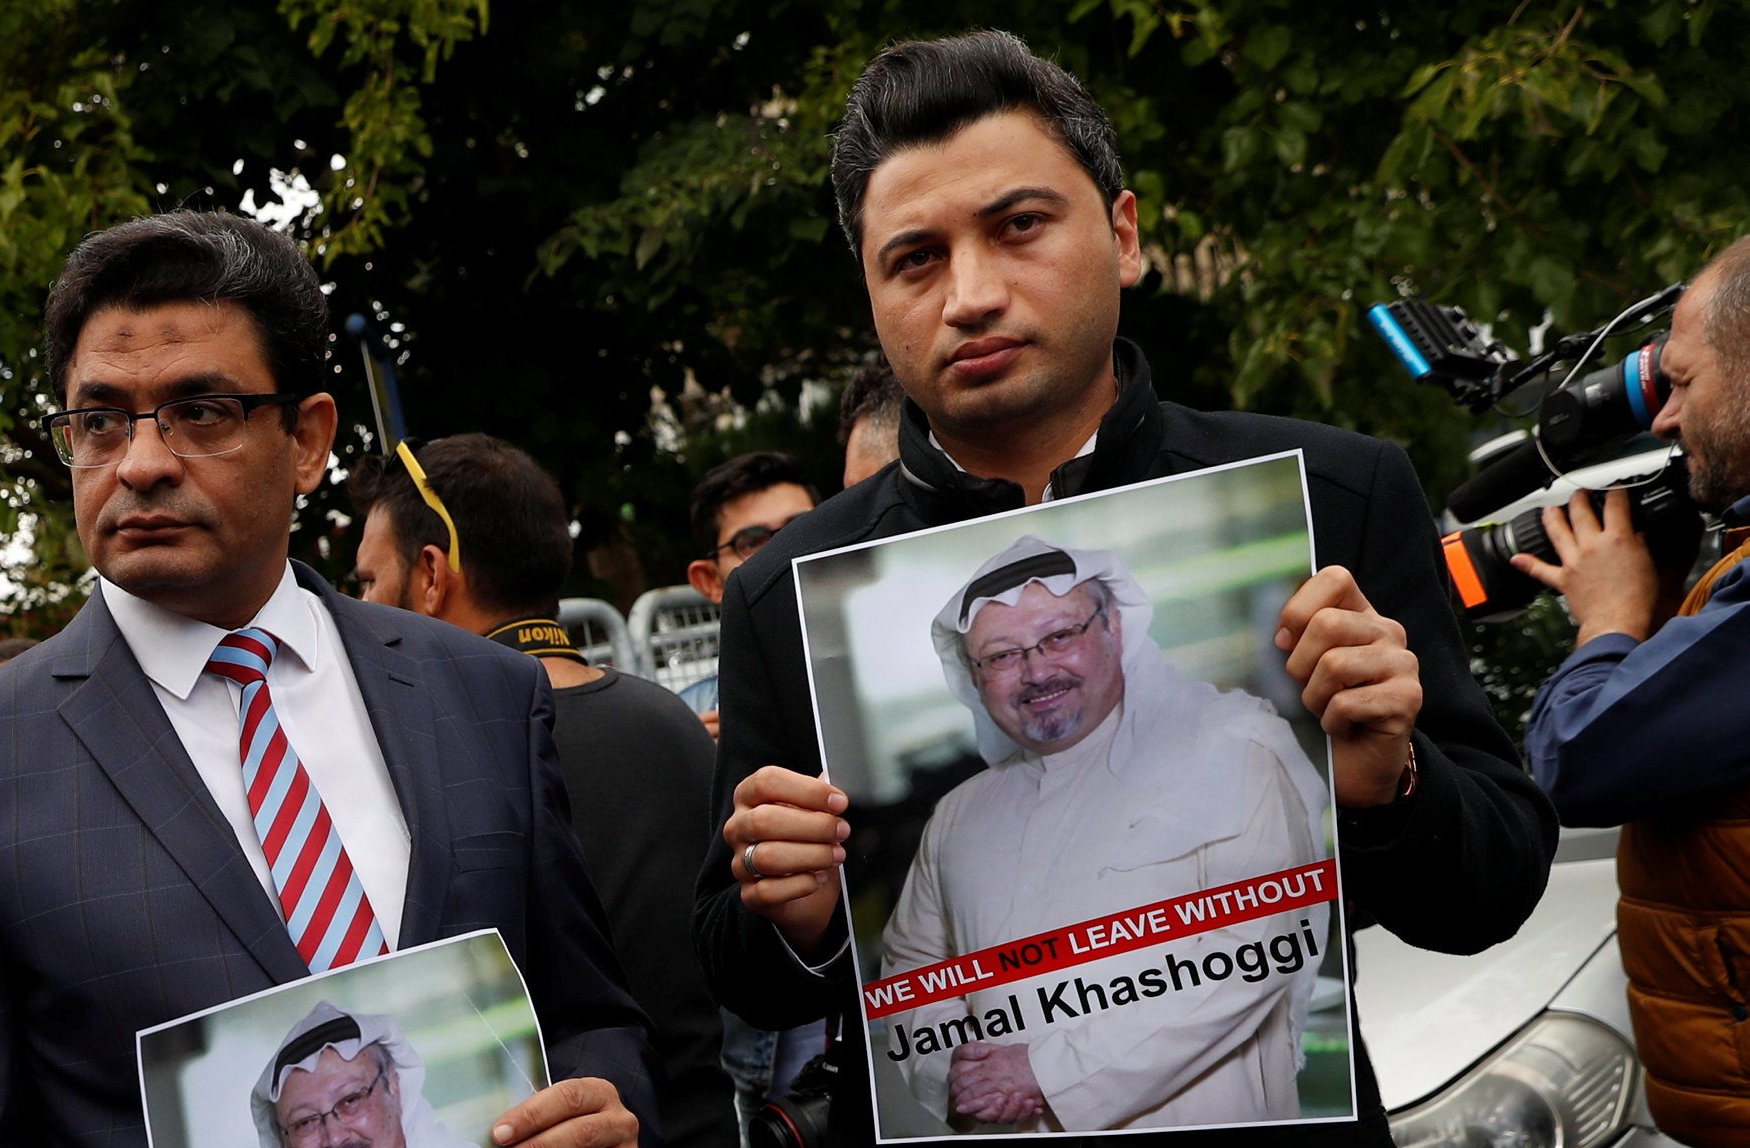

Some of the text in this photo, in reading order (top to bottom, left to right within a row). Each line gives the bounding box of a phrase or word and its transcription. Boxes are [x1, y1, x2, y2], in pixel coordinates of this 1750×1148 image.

[518, 626, 570, 646] Nikon
[865, 868, 1325, 1010] WE WILL NOT LEAVE WITHOUT
[887, 919, 1320, 1062] Jamal Khashoggi
